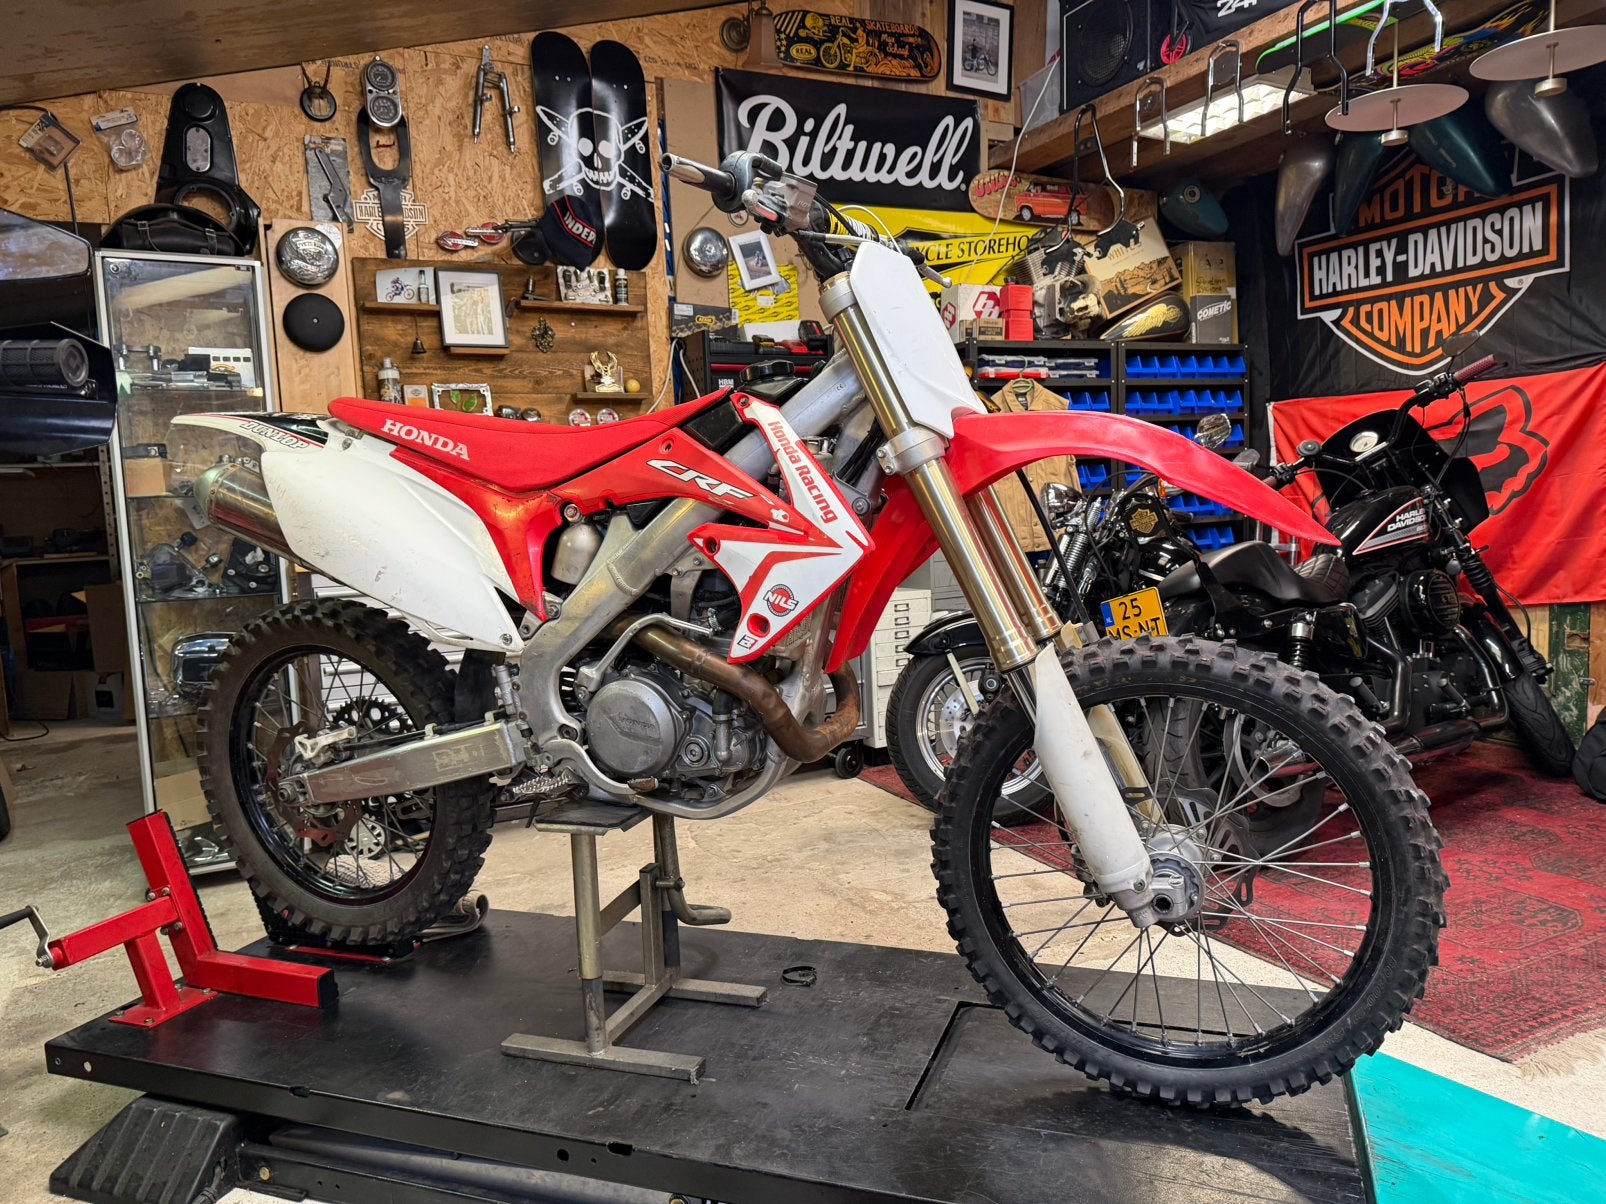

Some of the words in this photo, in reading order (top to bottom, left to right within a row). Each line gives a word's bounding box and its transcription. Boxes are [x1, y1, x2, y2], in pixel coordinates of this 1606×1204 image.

[1313, 201, 1543, 296] HARLEY-DAVIDSON
[1197, 300, 1231, 320] COMETIC
[1360, 283, 1483, 354] COMPANY
[239, 421, 310, 449] DUNLOP
[381, 418, 470, 461] HONDA
[646, 459, 756, 499] CRF
[768, 421, 802, 464] Honda
[795, 464, 838, 524] Racing
[764, 590, 798, 611] NILS
[1119, 598, 1142, 620] 25
